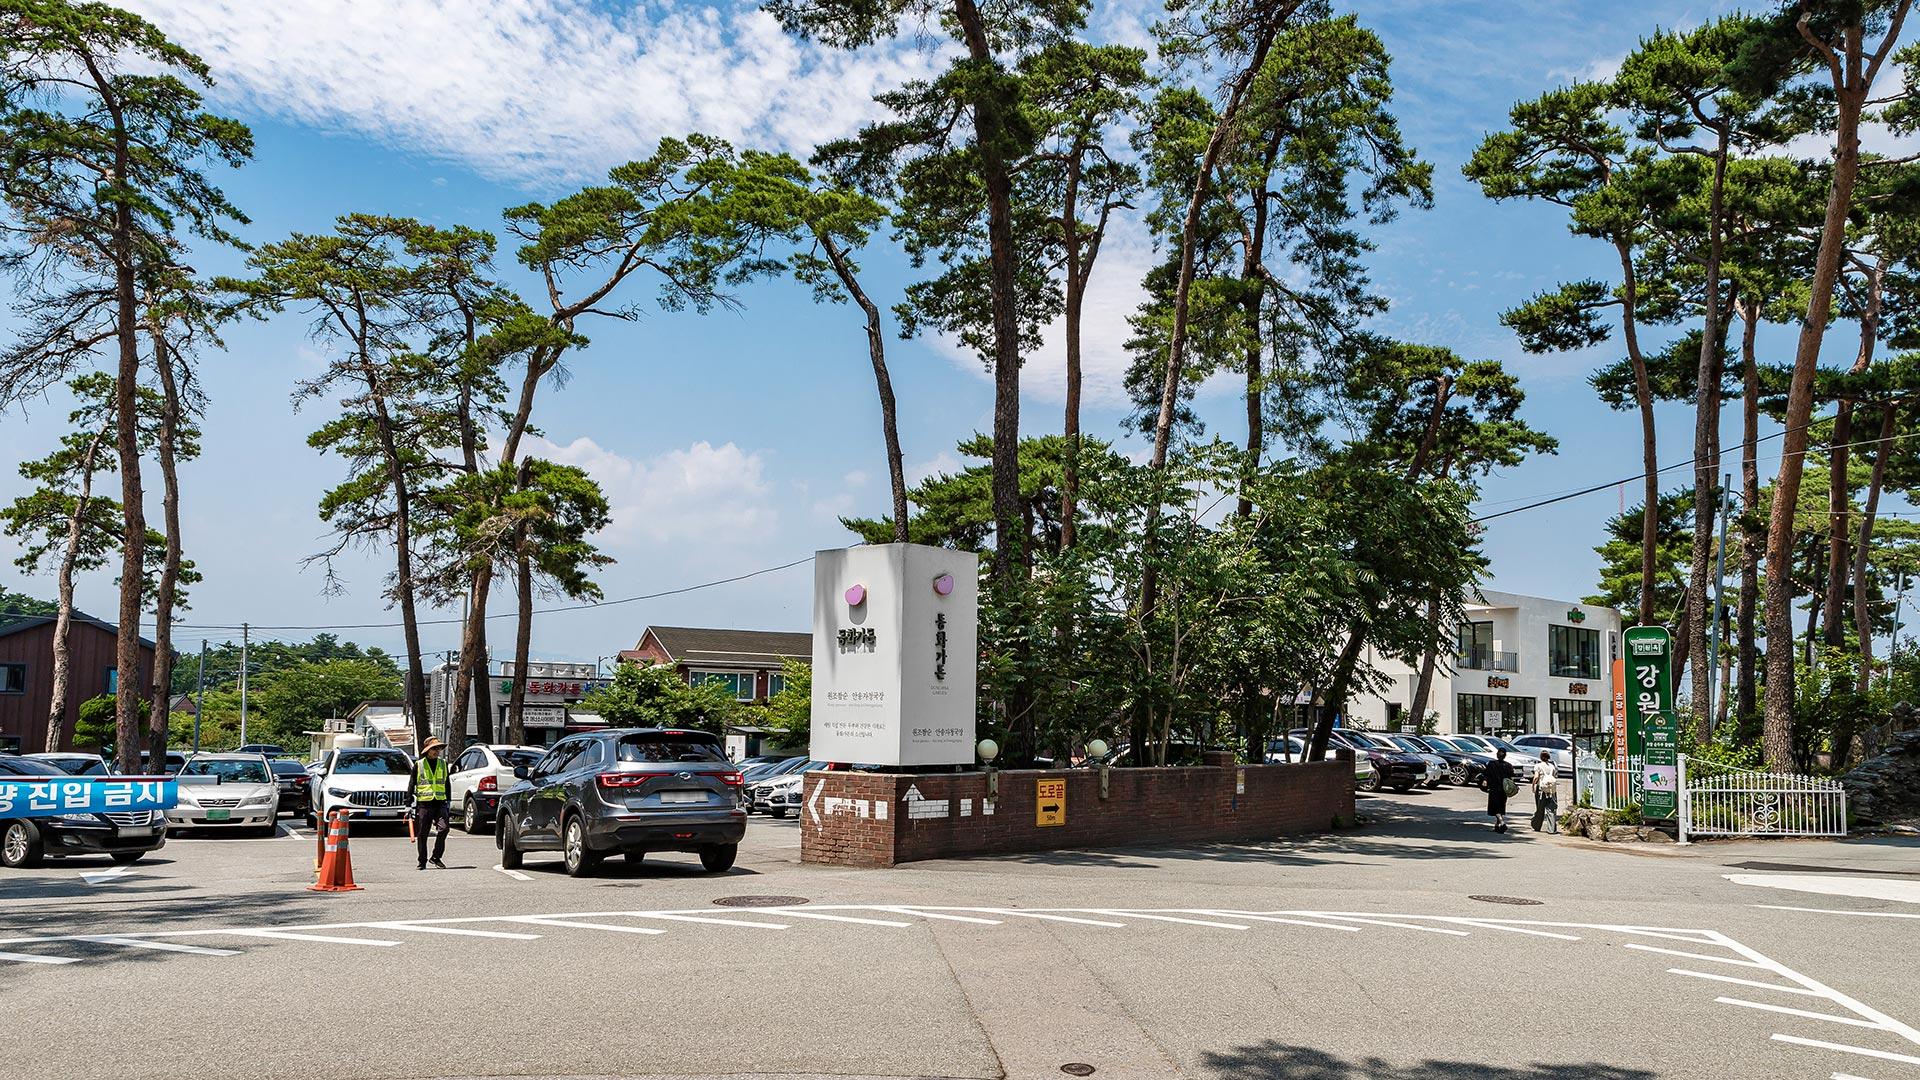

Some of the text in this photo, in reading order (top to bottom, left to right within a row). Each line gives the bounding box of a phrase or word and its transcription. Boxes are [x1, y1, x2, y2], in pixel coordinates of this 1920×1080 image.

[837, 628, 876, 646] 동화가든
[934, 613, 948, 680] 동화가든
[529, 682, 581, 695] 동화가든
[1636, 665, 1661, 718] 강원
[28, 782, 91, 810] 진입
[104, 781, 163, 806] 금지
[1039, 784, 1064, 799] 도로끝
